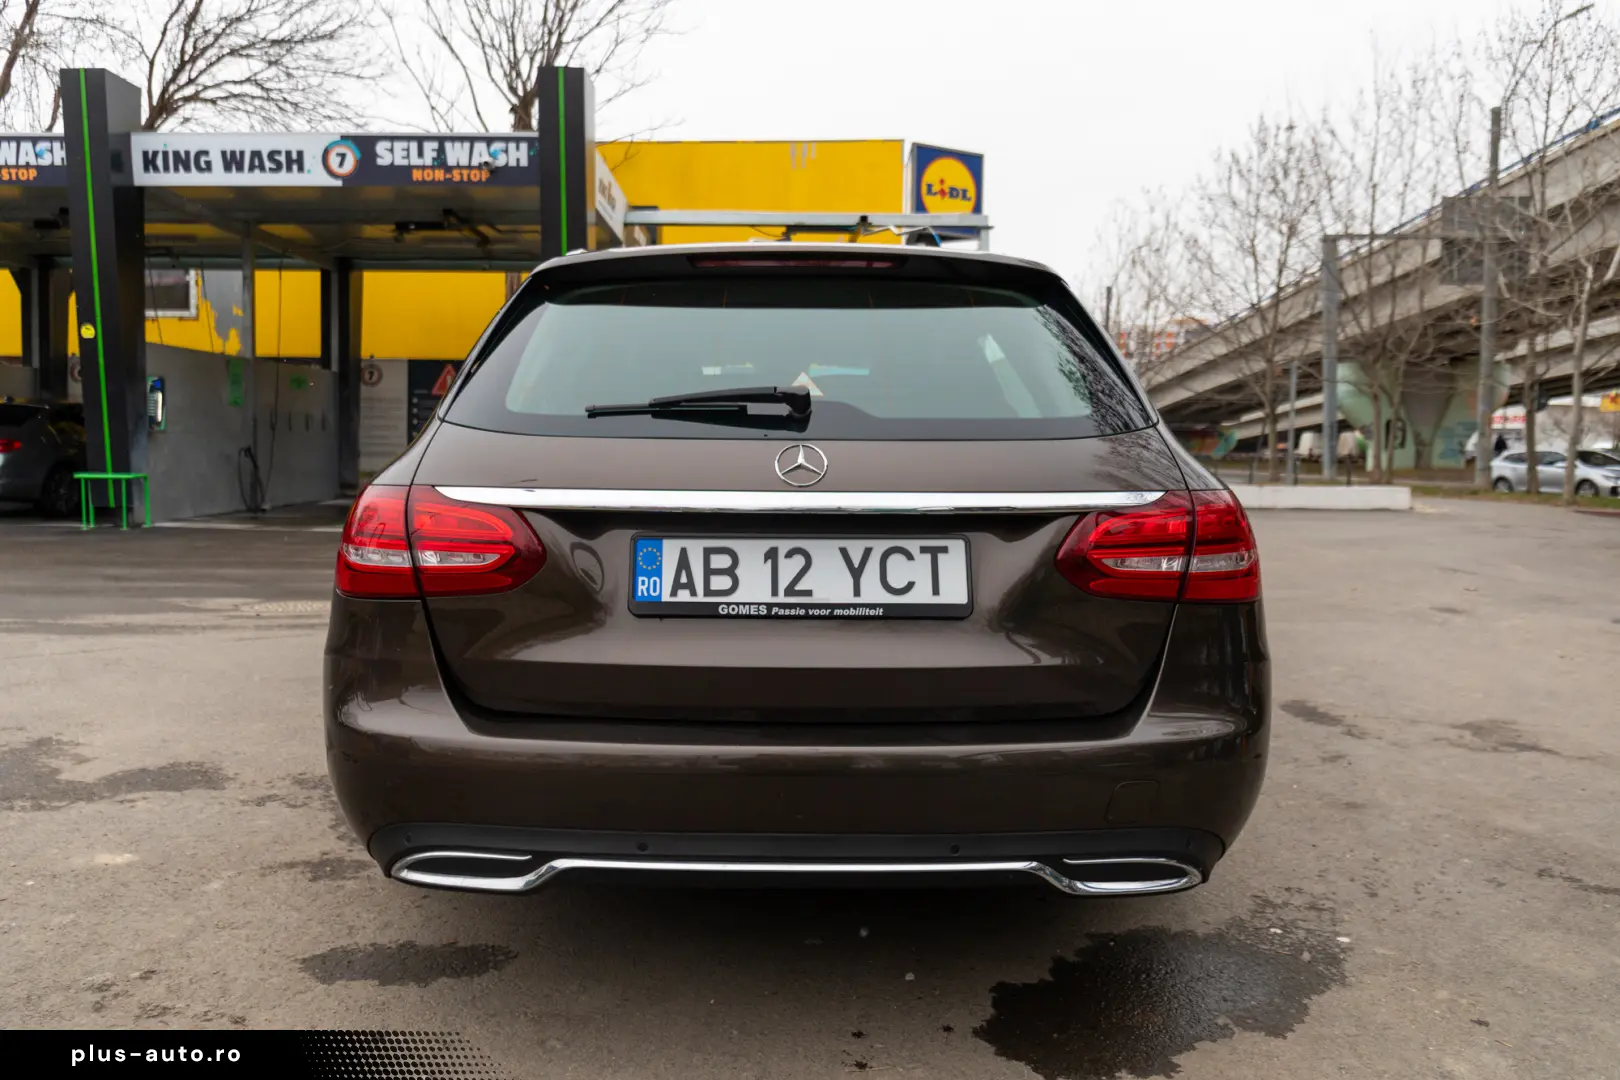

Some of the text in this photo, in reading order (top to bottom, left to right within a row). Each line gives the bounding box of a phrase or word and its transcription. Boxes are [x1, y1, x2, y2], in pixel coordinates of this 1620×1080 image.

[0, 140, 67, 166] WASH
[142, 148, 305, 174] KING WASH
[335, 152, 347, 168] 7
[375, 140, 528, 167] SELF WASH
[0, 168, 37, 181] STOP
[411, 168, 490, 182] NON-STOP
[669, 546, 948, 597] AB 12 YCT
[638, 577, 660, 596] RO
[718, 604, 883, 616] GOMES Passie voor mobiliteit
